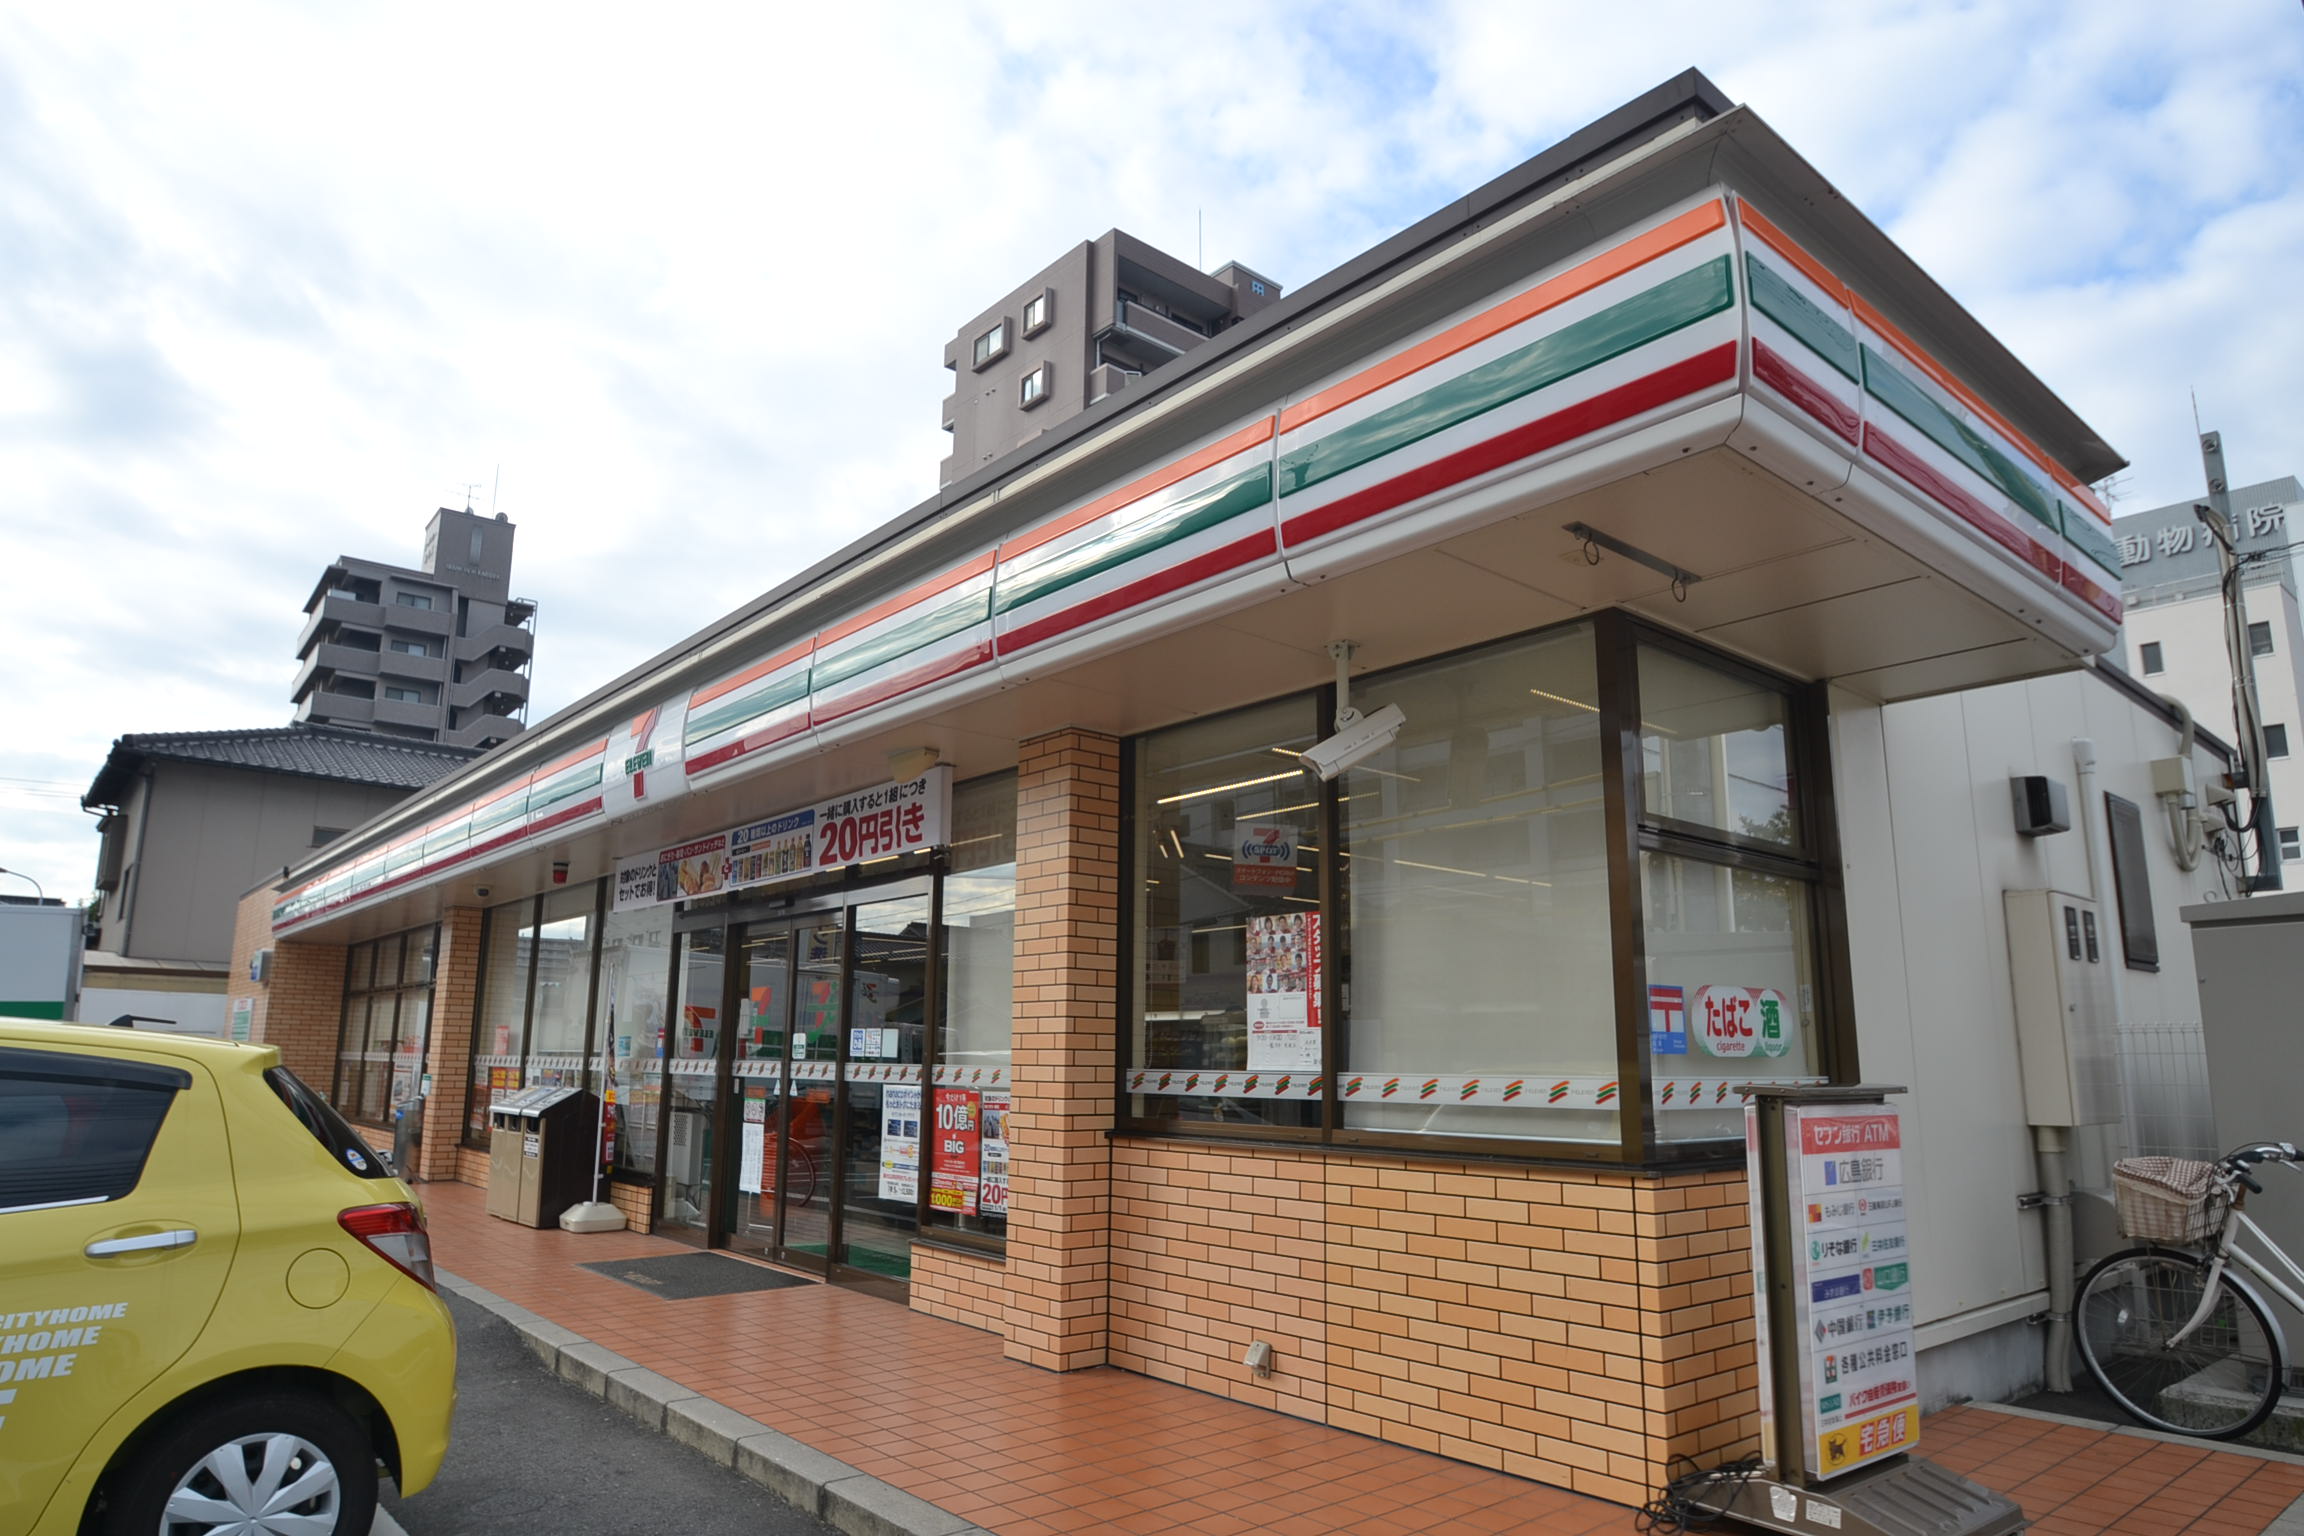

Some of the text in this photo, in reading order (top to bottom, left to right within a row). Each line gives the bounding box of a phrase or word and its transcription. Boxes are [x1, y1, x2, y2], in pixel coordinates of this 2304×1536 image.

[819, 802, 925, 867] 20円引き
[1704, 995, 1781, 1039] たばこ 酒
[1716, 1041, 1746, 1053] cigarette
[1813, 1122, 1889, 1146] セブン銀行 ATM
[943, 1139, 966, 1155] BIG
[1839, 1157, 1884, 1184] 広島銀行
[1821, 1238, 1857, 1258] りそな銀行
[1827, 1313, 1863, 1338] 中国銀行
[1860, 1411, 1906, 1453] 宅急便
